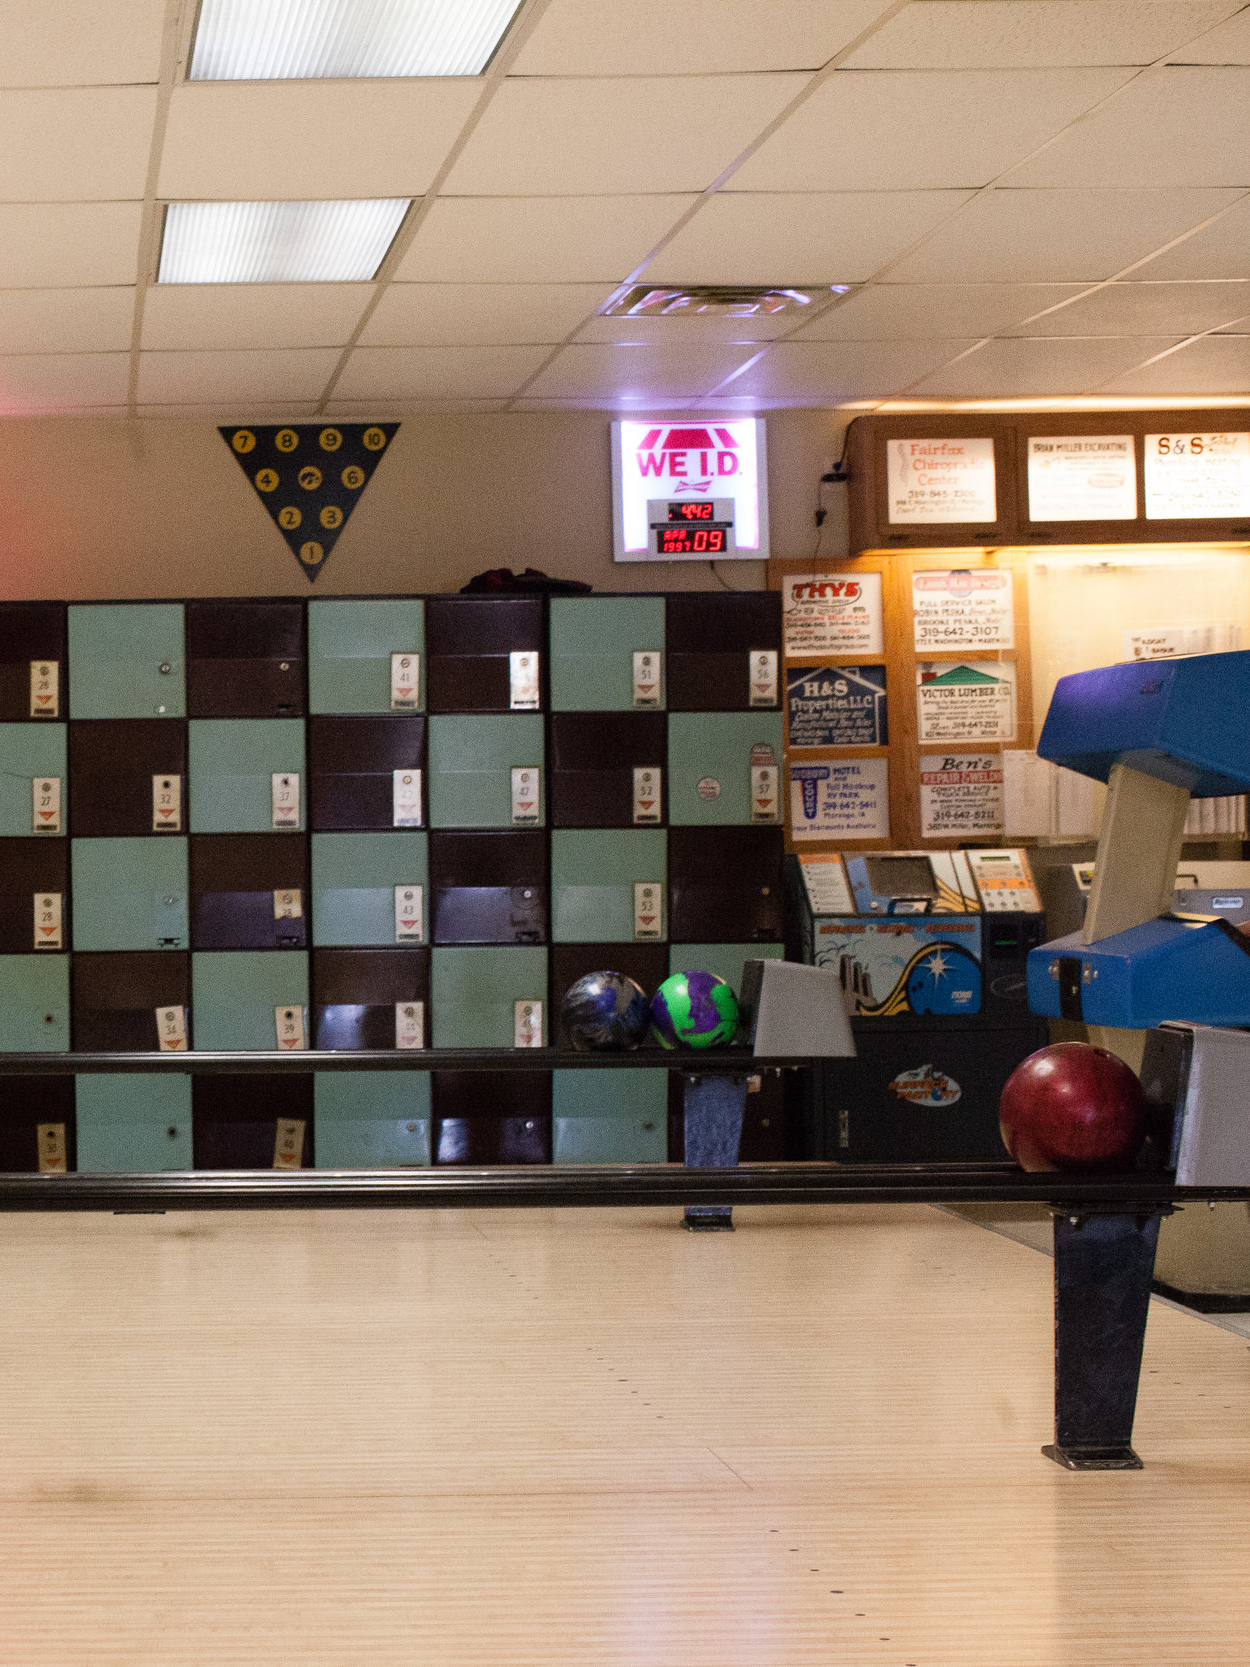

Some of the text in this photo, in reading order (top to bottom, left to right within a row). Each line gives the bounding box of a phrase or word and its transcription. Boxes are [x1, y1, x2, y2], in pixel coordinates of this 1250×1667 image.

[239, 433, 380, 448] 7 8 9 10
[1158, 437, 1170, 455] S
[1173, 440, 1185, 454] &
[1190, 437, 1203, 455] S
[910, 443, 965, 456] Fairfax
[636, 451, 743, 477] WE I.D.
[261, 471, 358, 487] 4 6
[918, 473, 959, 486] Center
[286, 511, 336, 524] 2 3
[663, 530, 687, 540] APR
[663, 541, 691, 552] 1997
[693, 531, 723, 551] 09
[920, 626, 999, 637] 319-642-3107
[399, 672, 410, 683] 41
[641, 669, 652, 681] 51
[757, 669, 769, 680] 56
[803, 680, 849, 697] H&S
[922, 689, 955, 697] VICTOR
[959, 688, 995, 697] LUMBER
[791, 696, 872, 713] Properties LLC
[940, 758, 993, 771] Ben's
[833, 767, 861, 775] MOTEL
[923, 772, 960, 784] REPAIR
[640, 786, 653, 796] 52
[757, 783, 771, 794] 57
[40, 796, 52, 807] 27
[160, 794, 172, 805] 32
[279, 791, 291, 802] 37
[402, 905, 414, 915] 43
[641, 901, 653, 912] 53
[42, 911, 53, 922] 28
[285, 1023, 295, 1034] 39
